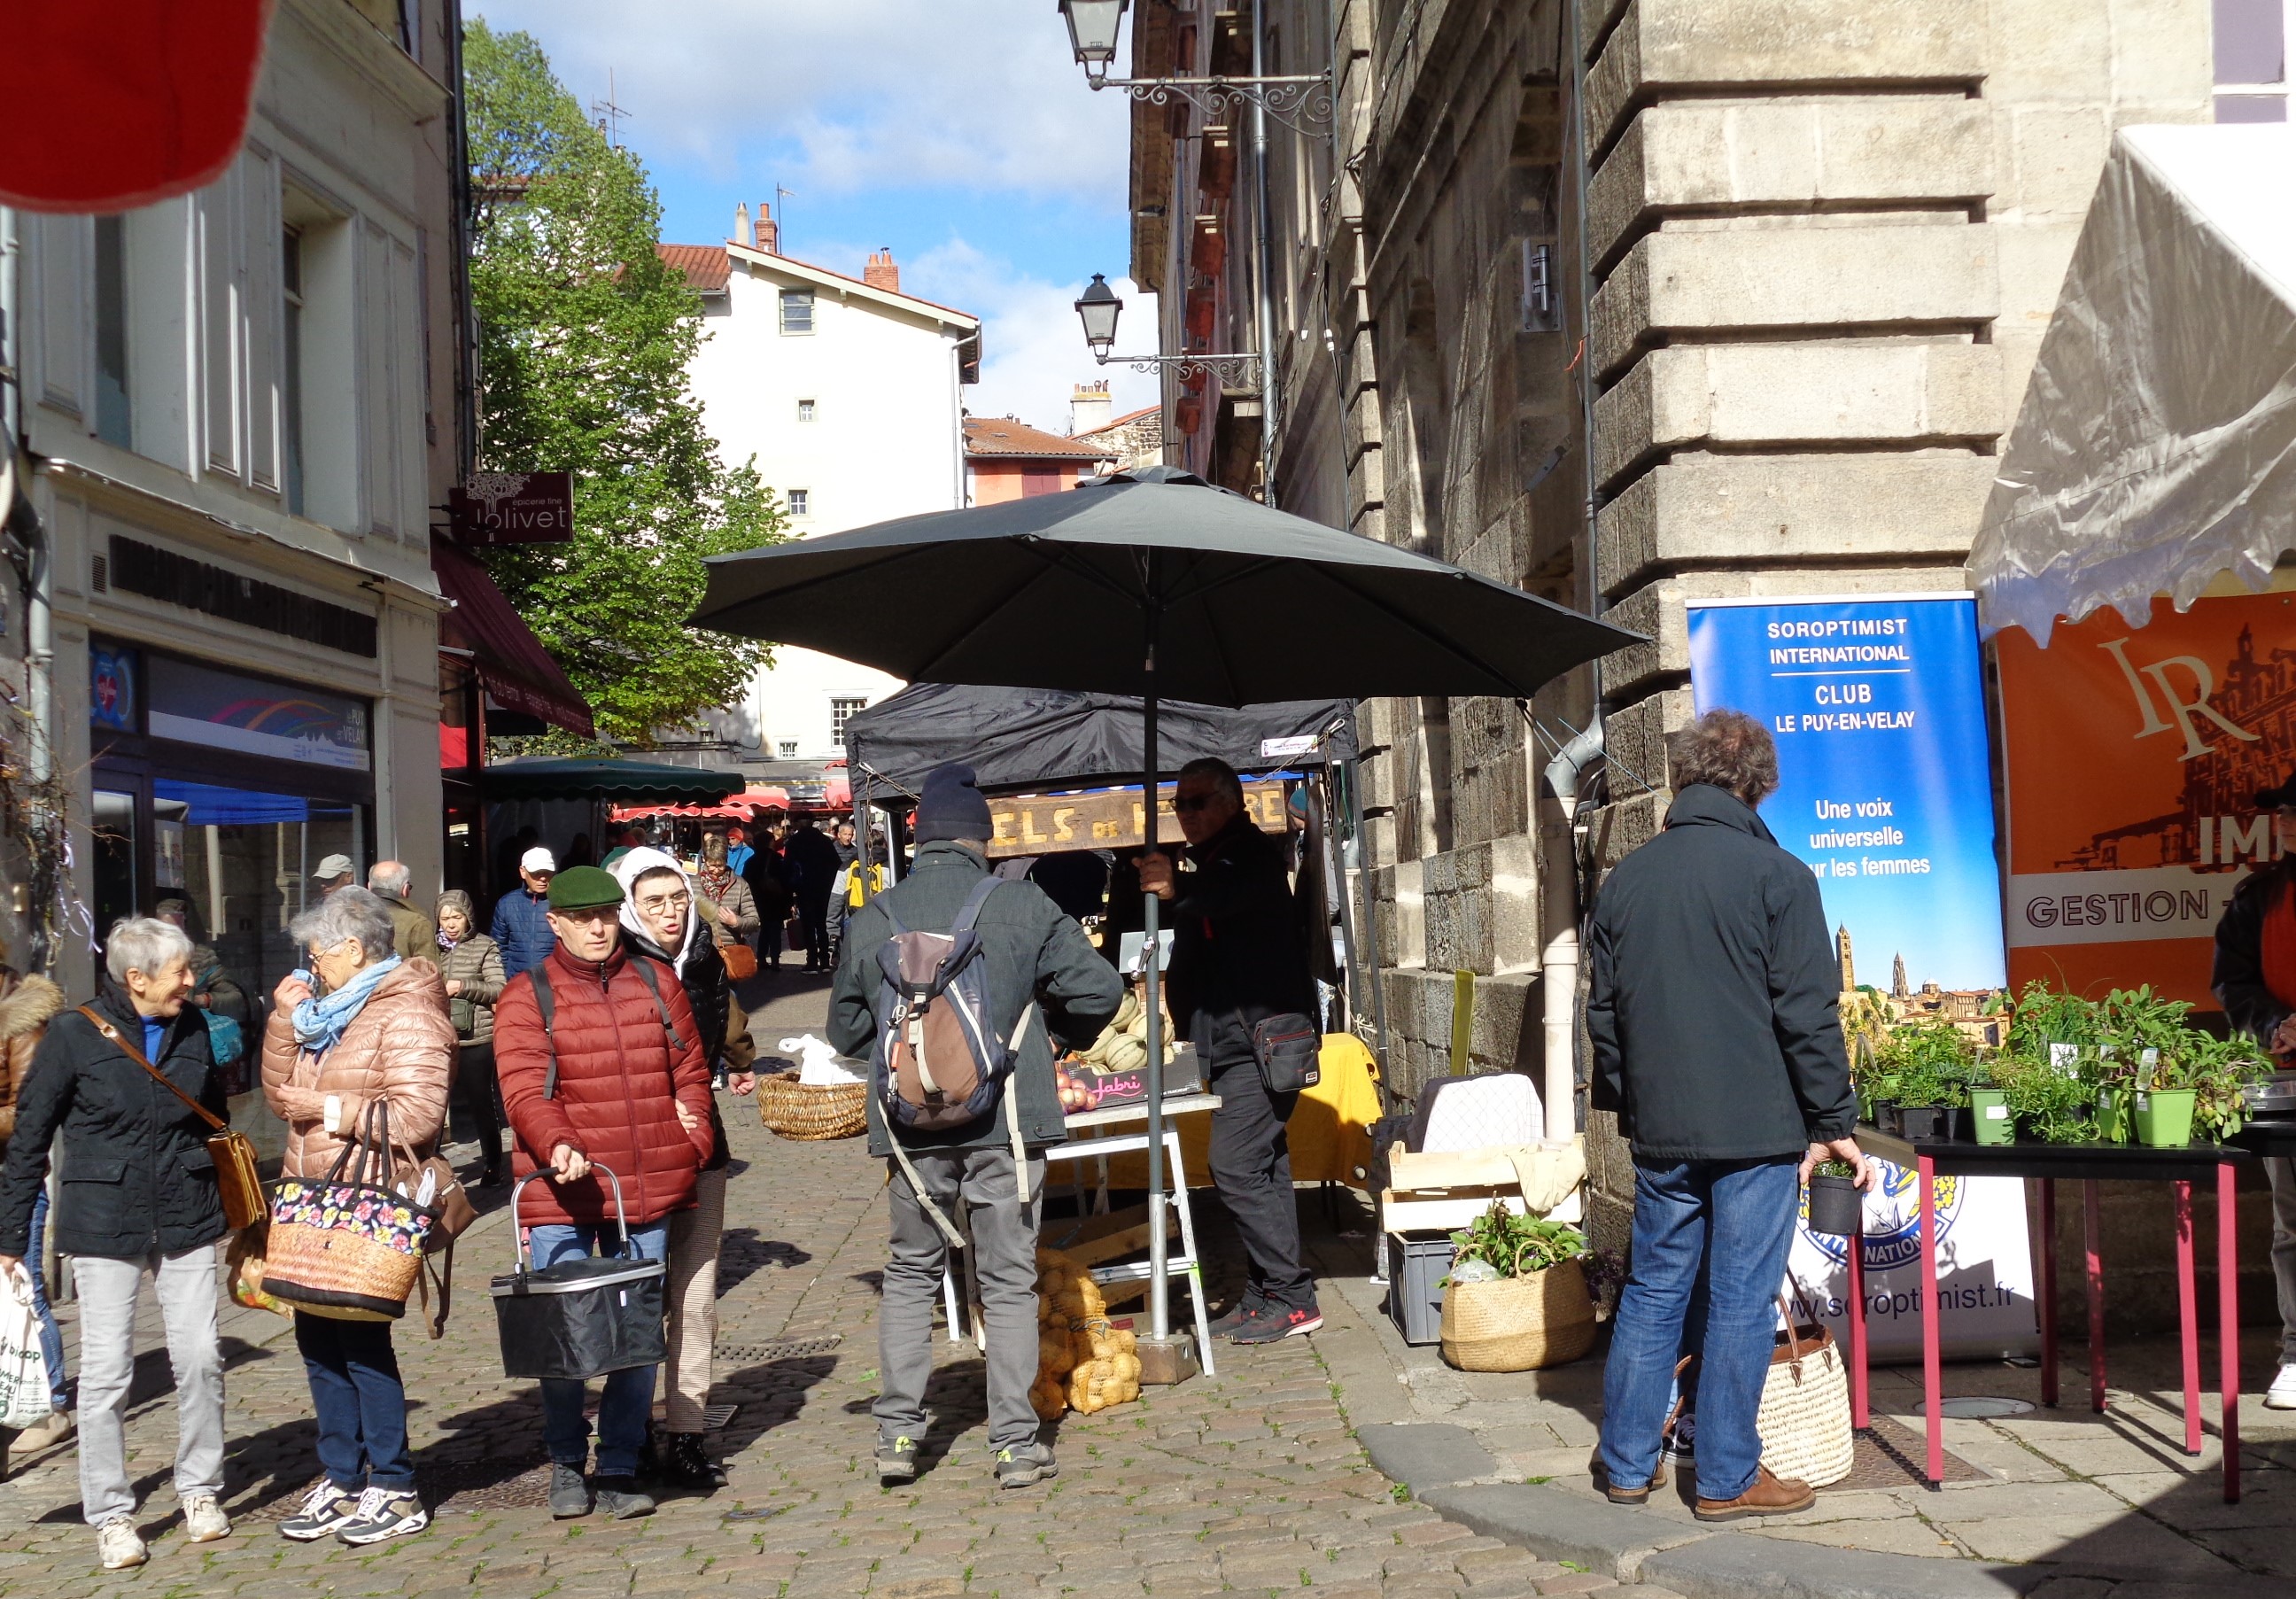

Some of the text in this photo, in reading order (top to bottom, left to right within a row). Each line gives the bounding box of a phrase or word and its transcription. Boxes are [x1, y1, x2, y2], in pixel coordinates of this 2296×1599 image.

[1767, 618, 1907, 639] SOROPTIMIST
[1770, 645, 1910, 664] INTERNATIONAL
[1816, 684, 1872, 705] CLUB
[1776, 711, 1915, 733] LE PUY-EN-VELAY
[1816, 797, 1893, 819] Une voix
[992, 806, 1074, 847] ELS
[1810, 826, 1904, 849] universelle
[1808, 857, 1931, 878] ur les femmes
[2026, 889, 2208, 928] GESTION
